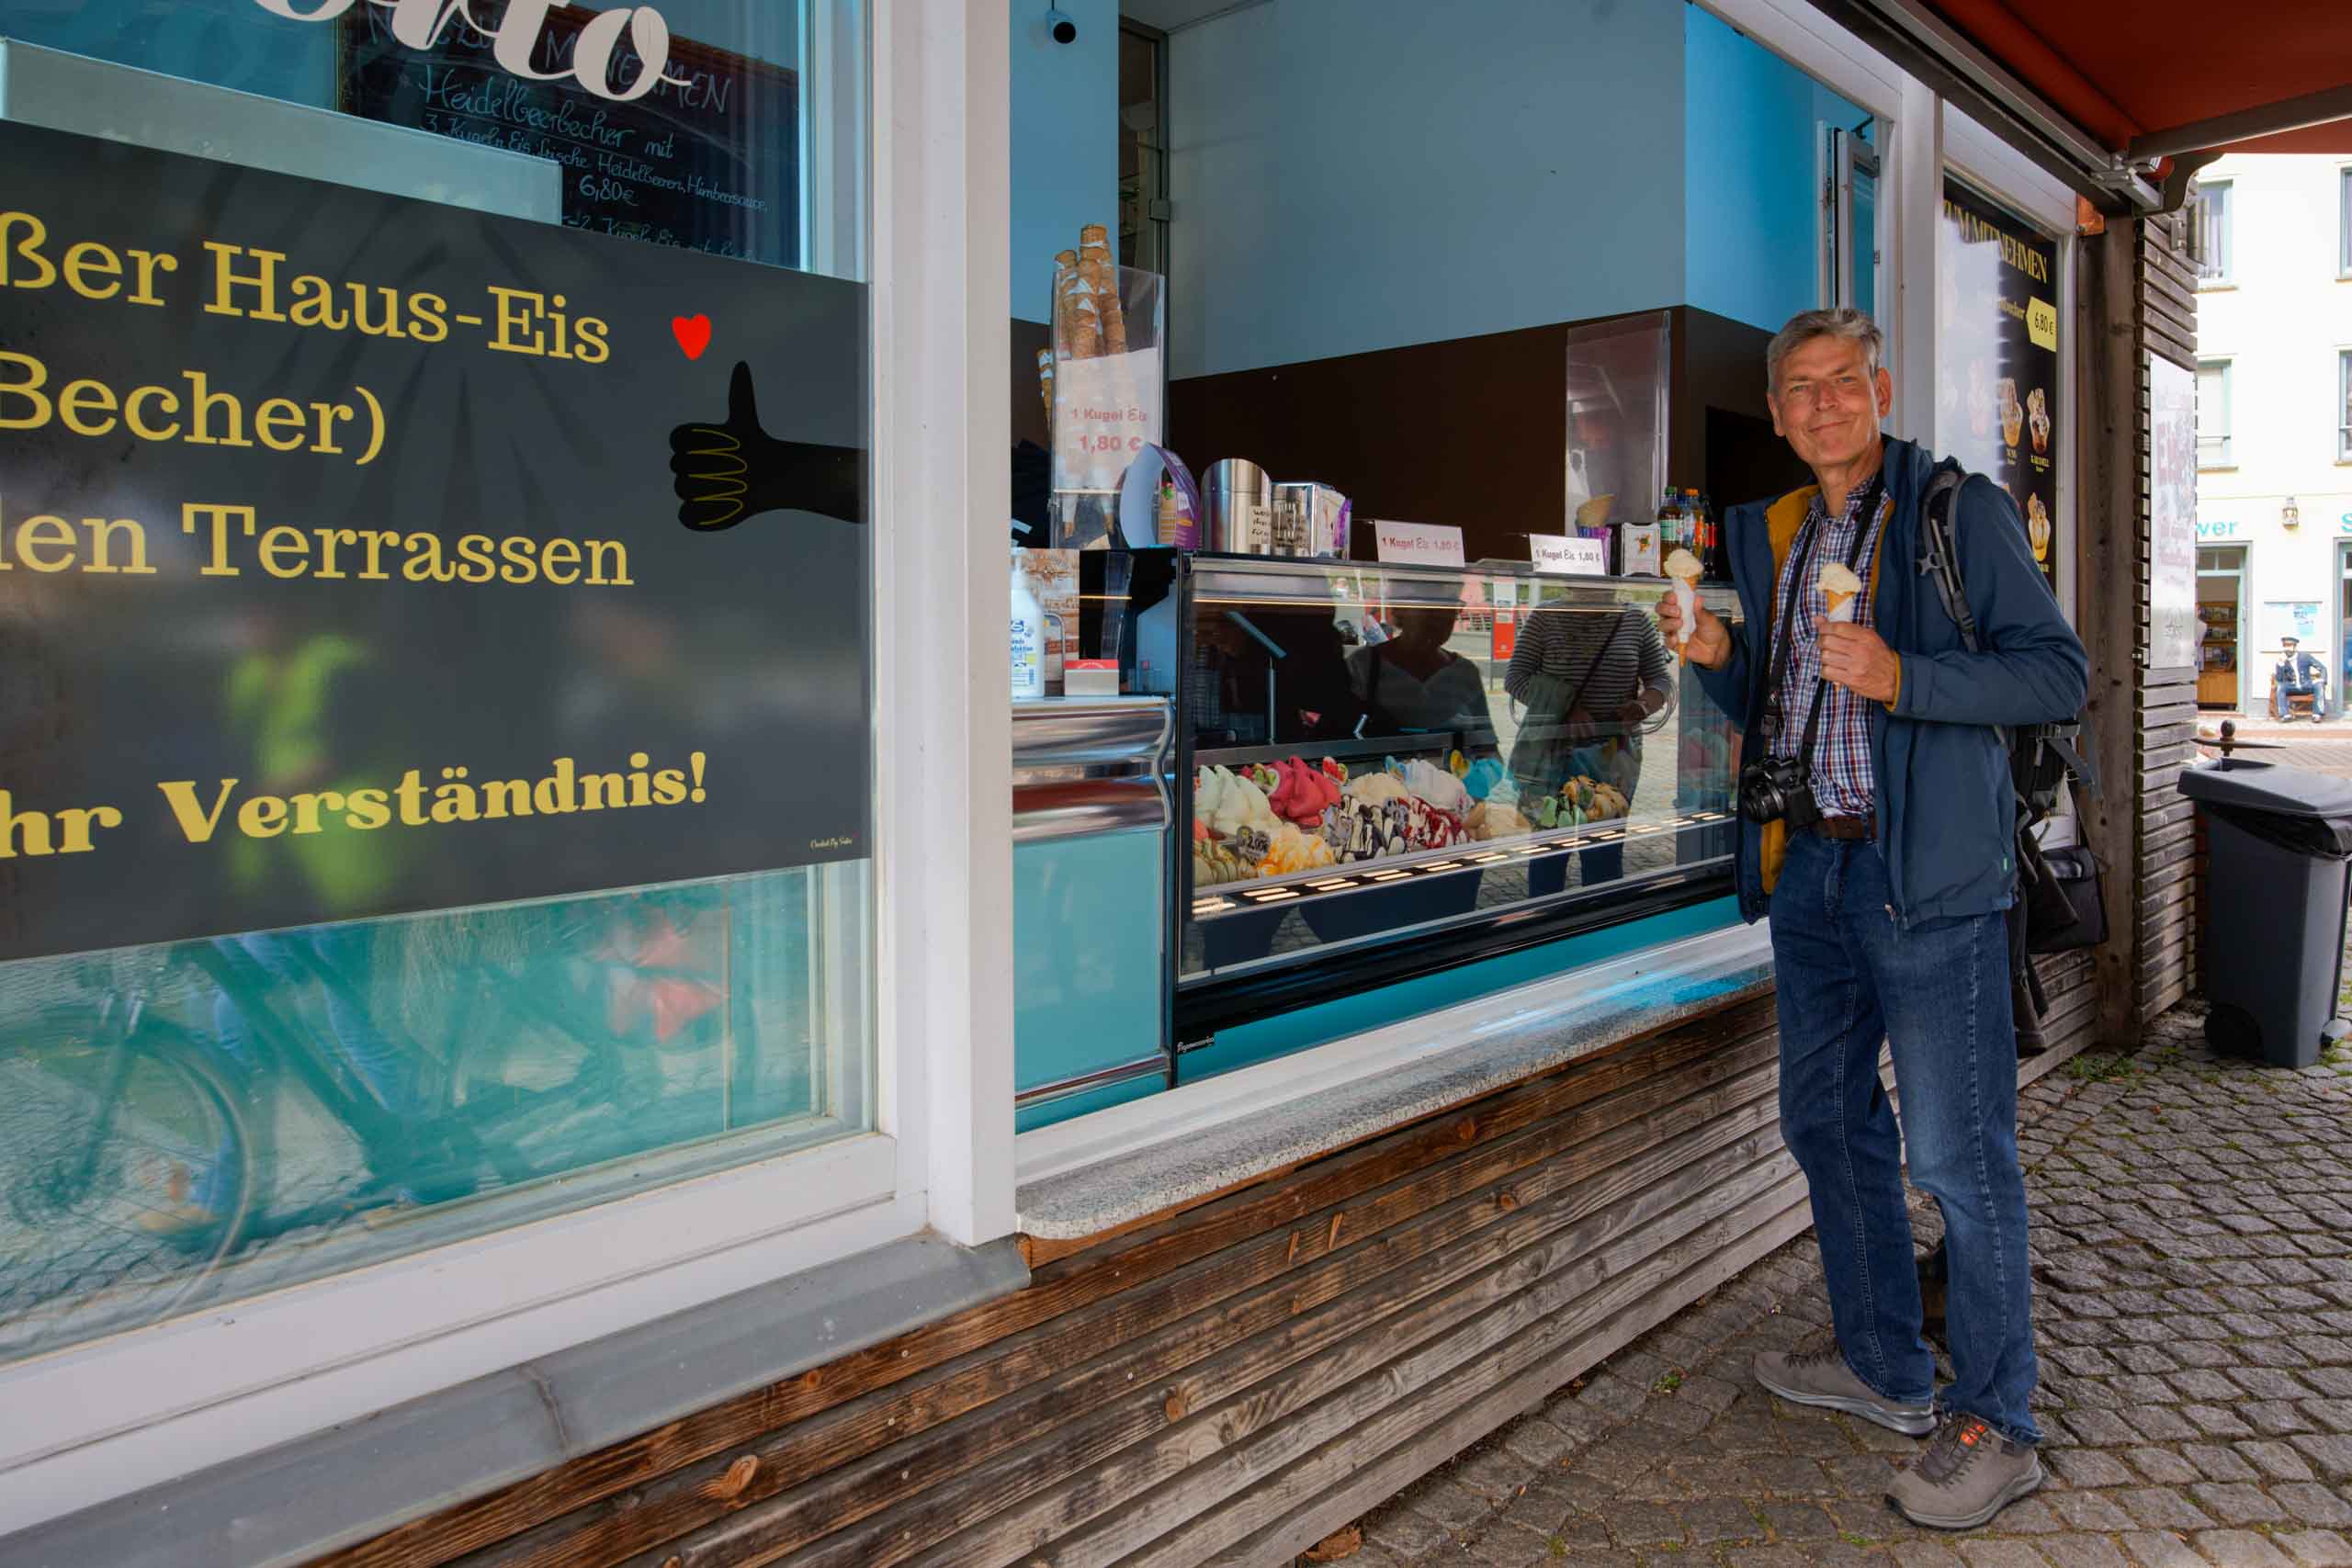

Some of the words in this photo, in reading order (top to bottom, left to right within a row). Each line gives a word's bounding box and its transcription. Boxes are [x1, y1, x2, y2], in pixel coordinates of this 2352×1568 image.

[644, 133, 674, 159] mit
[203, 241, 610, 364] Haus-Eis
[0, 351, 385, 465] Becher)
[1080, 434, 1122, 455] 1,80
[1084, 408, 1123, 423] Kugel
[0, 493, 156, 574] en
[182, 502, 633, 585] Terrassen
[158, 751, 706, 843] Verständnis!
